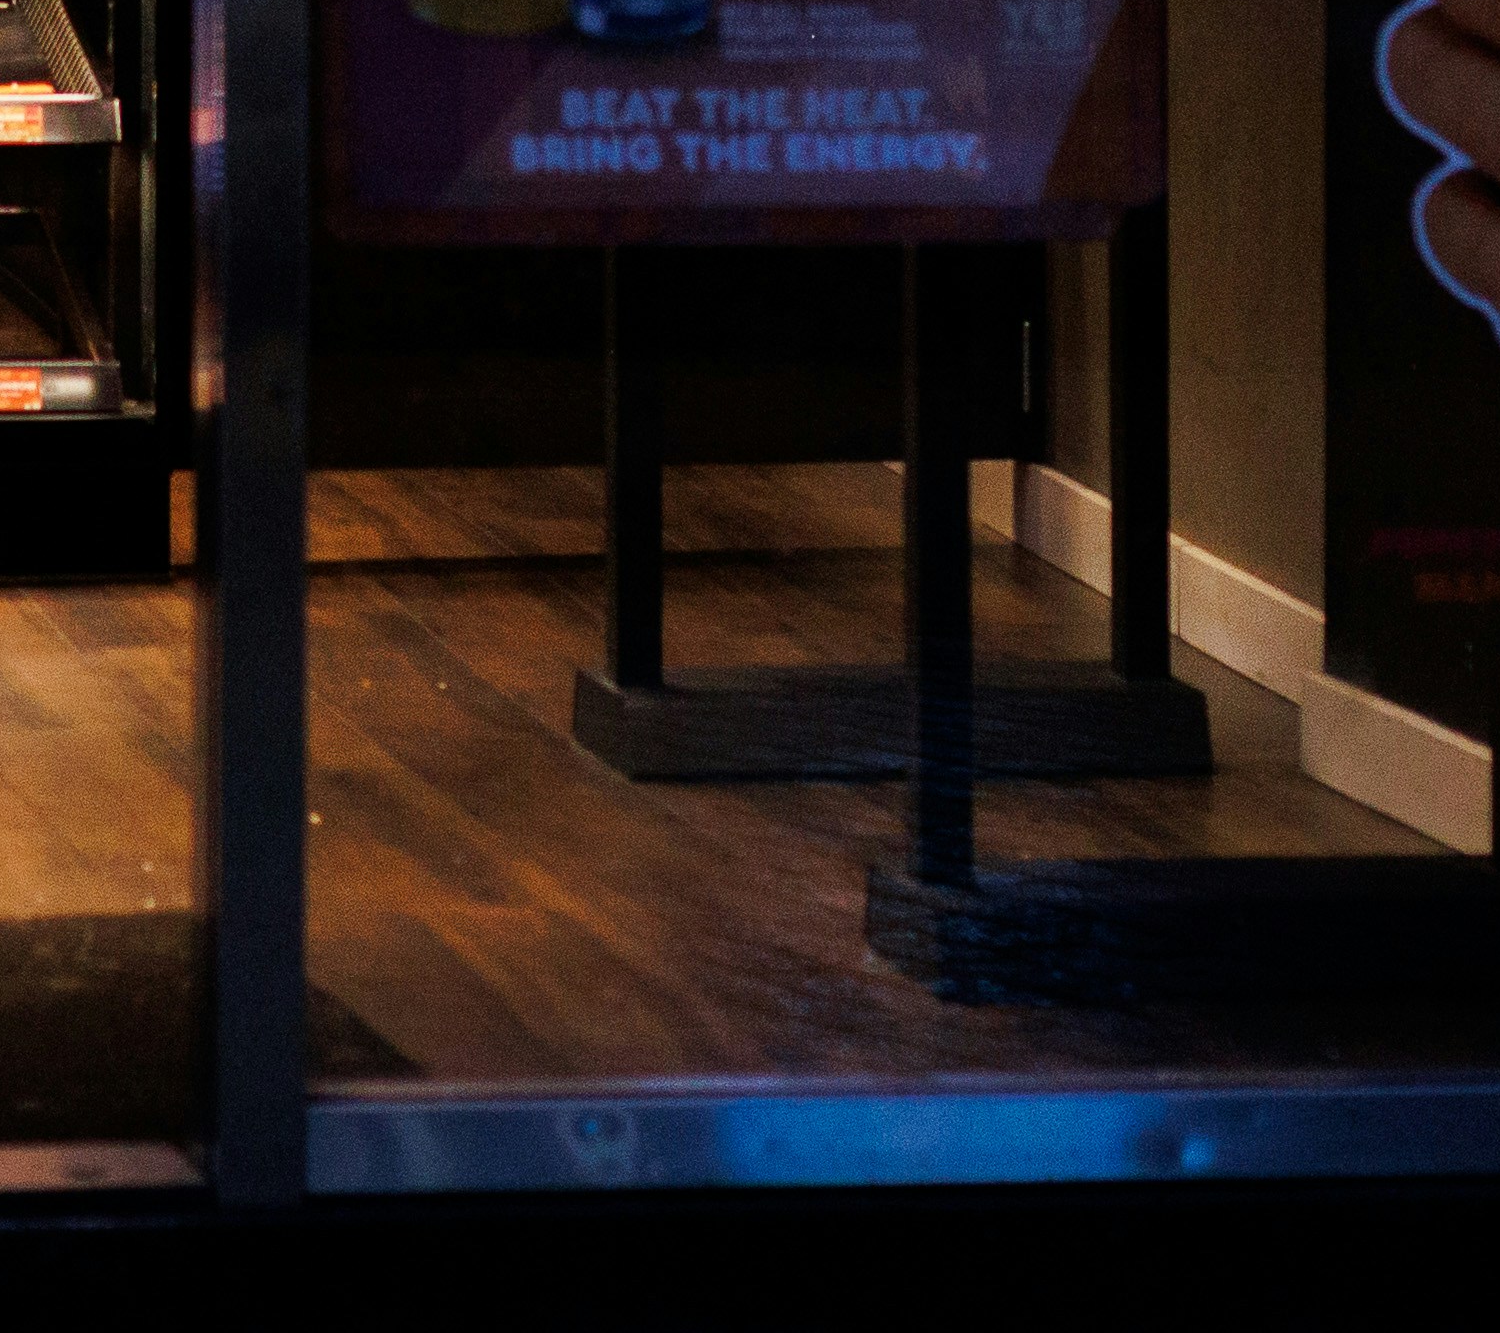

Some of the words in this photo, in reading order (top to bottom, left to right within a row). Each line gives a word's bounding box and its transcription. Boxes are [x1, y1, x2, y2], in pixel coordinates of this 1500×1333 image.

[561, 88, 689, 132] BEAT
[696, 88, 786, 132] THE
[511, 134, 661, 174] BRING
[679, 134, 774, 174] THE
